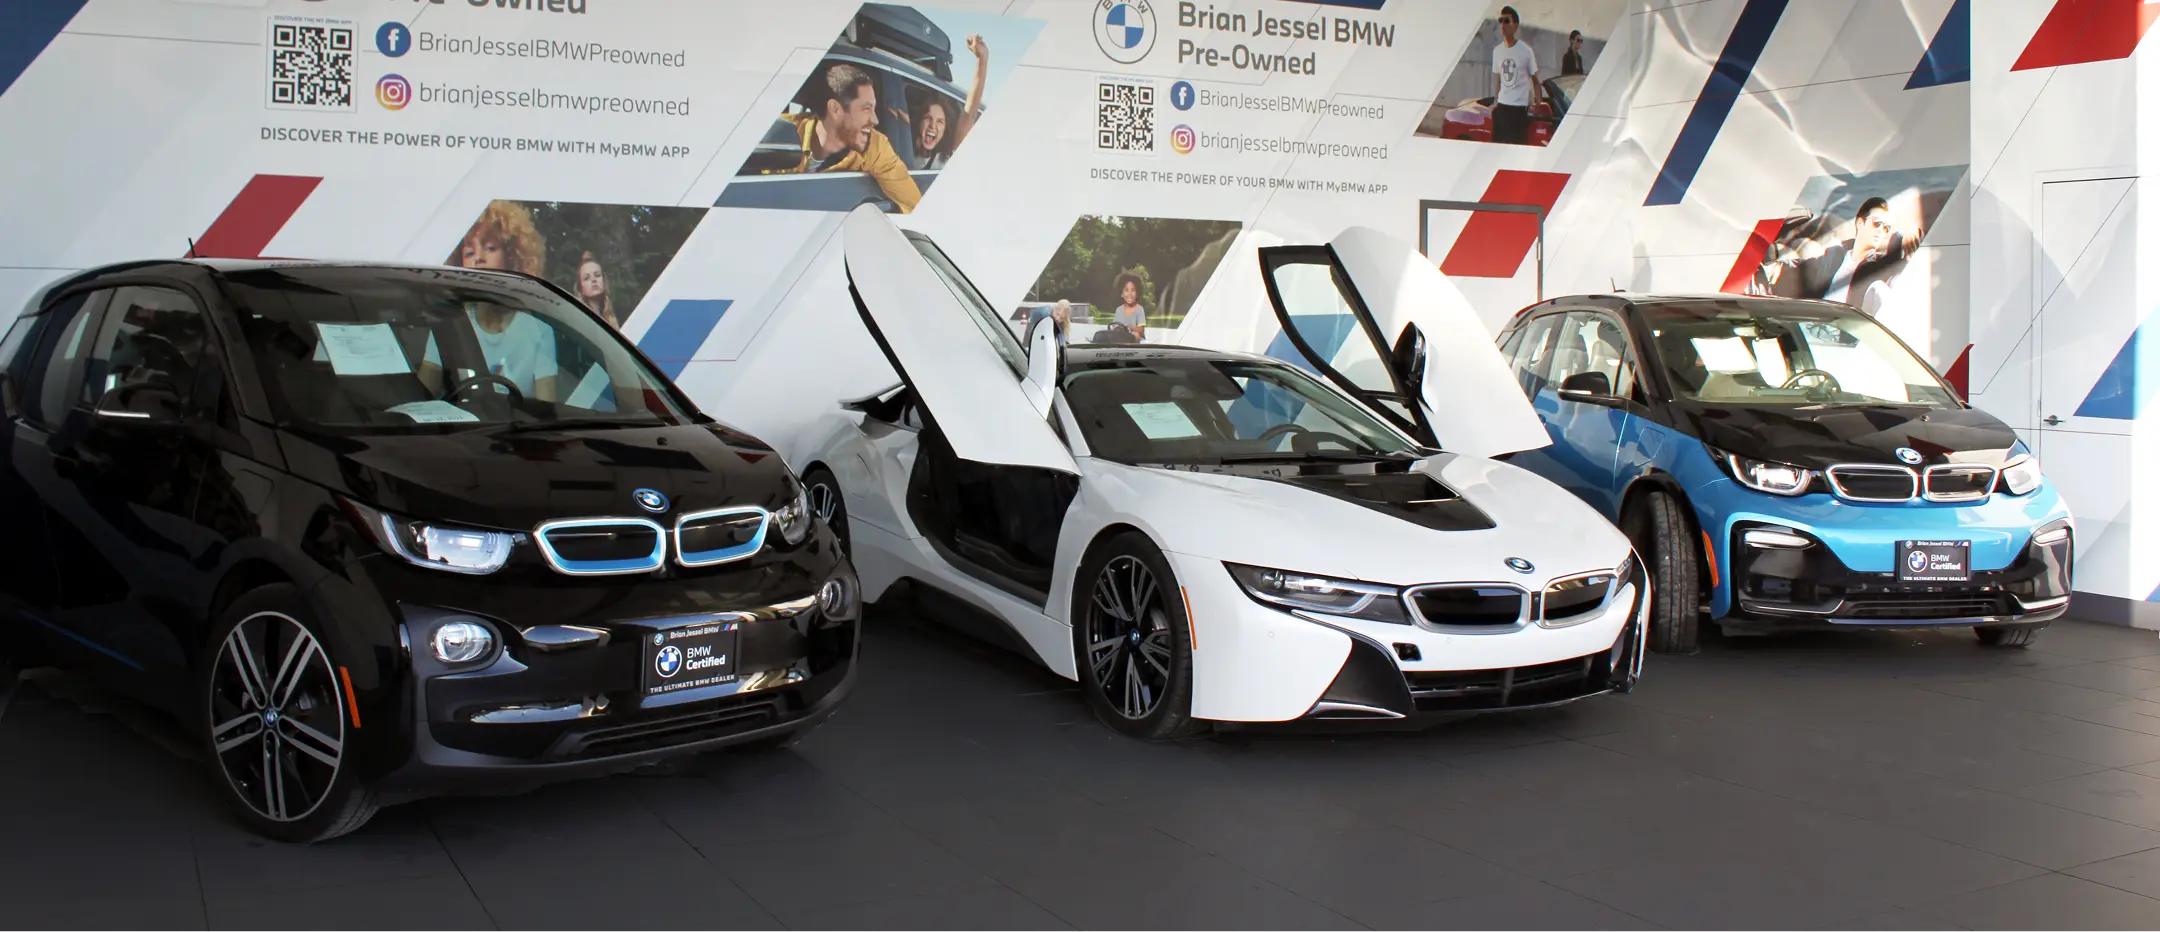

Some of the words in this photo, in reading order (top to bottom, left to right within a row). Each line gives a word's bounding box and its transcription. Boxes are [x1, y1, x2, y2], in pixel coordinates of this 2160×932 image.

[1179, 1, 1246, 32] Brian
[1253, 10, 1326, 40] Jessel
[1334, 19, 1395, 47] BMW
[419, 32, 685, 68] BrianJesselBMWPreowned
[1179, 40, 1316, 75] Pre-Owned
[420, 82, 689, 116] brianjesselbmwpreowned
[1200, 90, 1384, 119] BrianJesselBMWPreowned
[261, 127, 342, 142] DISCOVER
[347, 130, 379, 144] THE
[384, 132, 441, 147] POWER
[445, 134, 465, 148] OF
[469, 135, 512, 150] YOUR
[517, 138, 552, 152] BMW
[557, 140, 595, 154] WITH
[600, 142, 656, 158] MyBMW
[661, 145, 690, 158] APP
[1201, 132, 1388, 160] brianjesselbmwpreowned
[1091, 168, 1148, 181] DISCOVER
[1151, 172, 1173, 183] THE
[1177, 173, 1216, 185] POWER
[1220, 175, 1234, 186] OF
[1236, 176, 1266, 187] YOUR
[1269, 178, 1294, 189] BMW
[1297, 180, 1323, 191] WITH
[1327, 182, 1365, 193] MyBMW
[1368, 184, 1388, 194] APP
[686, 629, 703, 637] Jessel
[704, 626, 719, 634] BMW
[686, 655, 726, 670] Certified
[687, 646, 711, 658] BMW
[664, 681, 694, 691] ULTIMATE
[712, 675, 735, 683] DEALER
